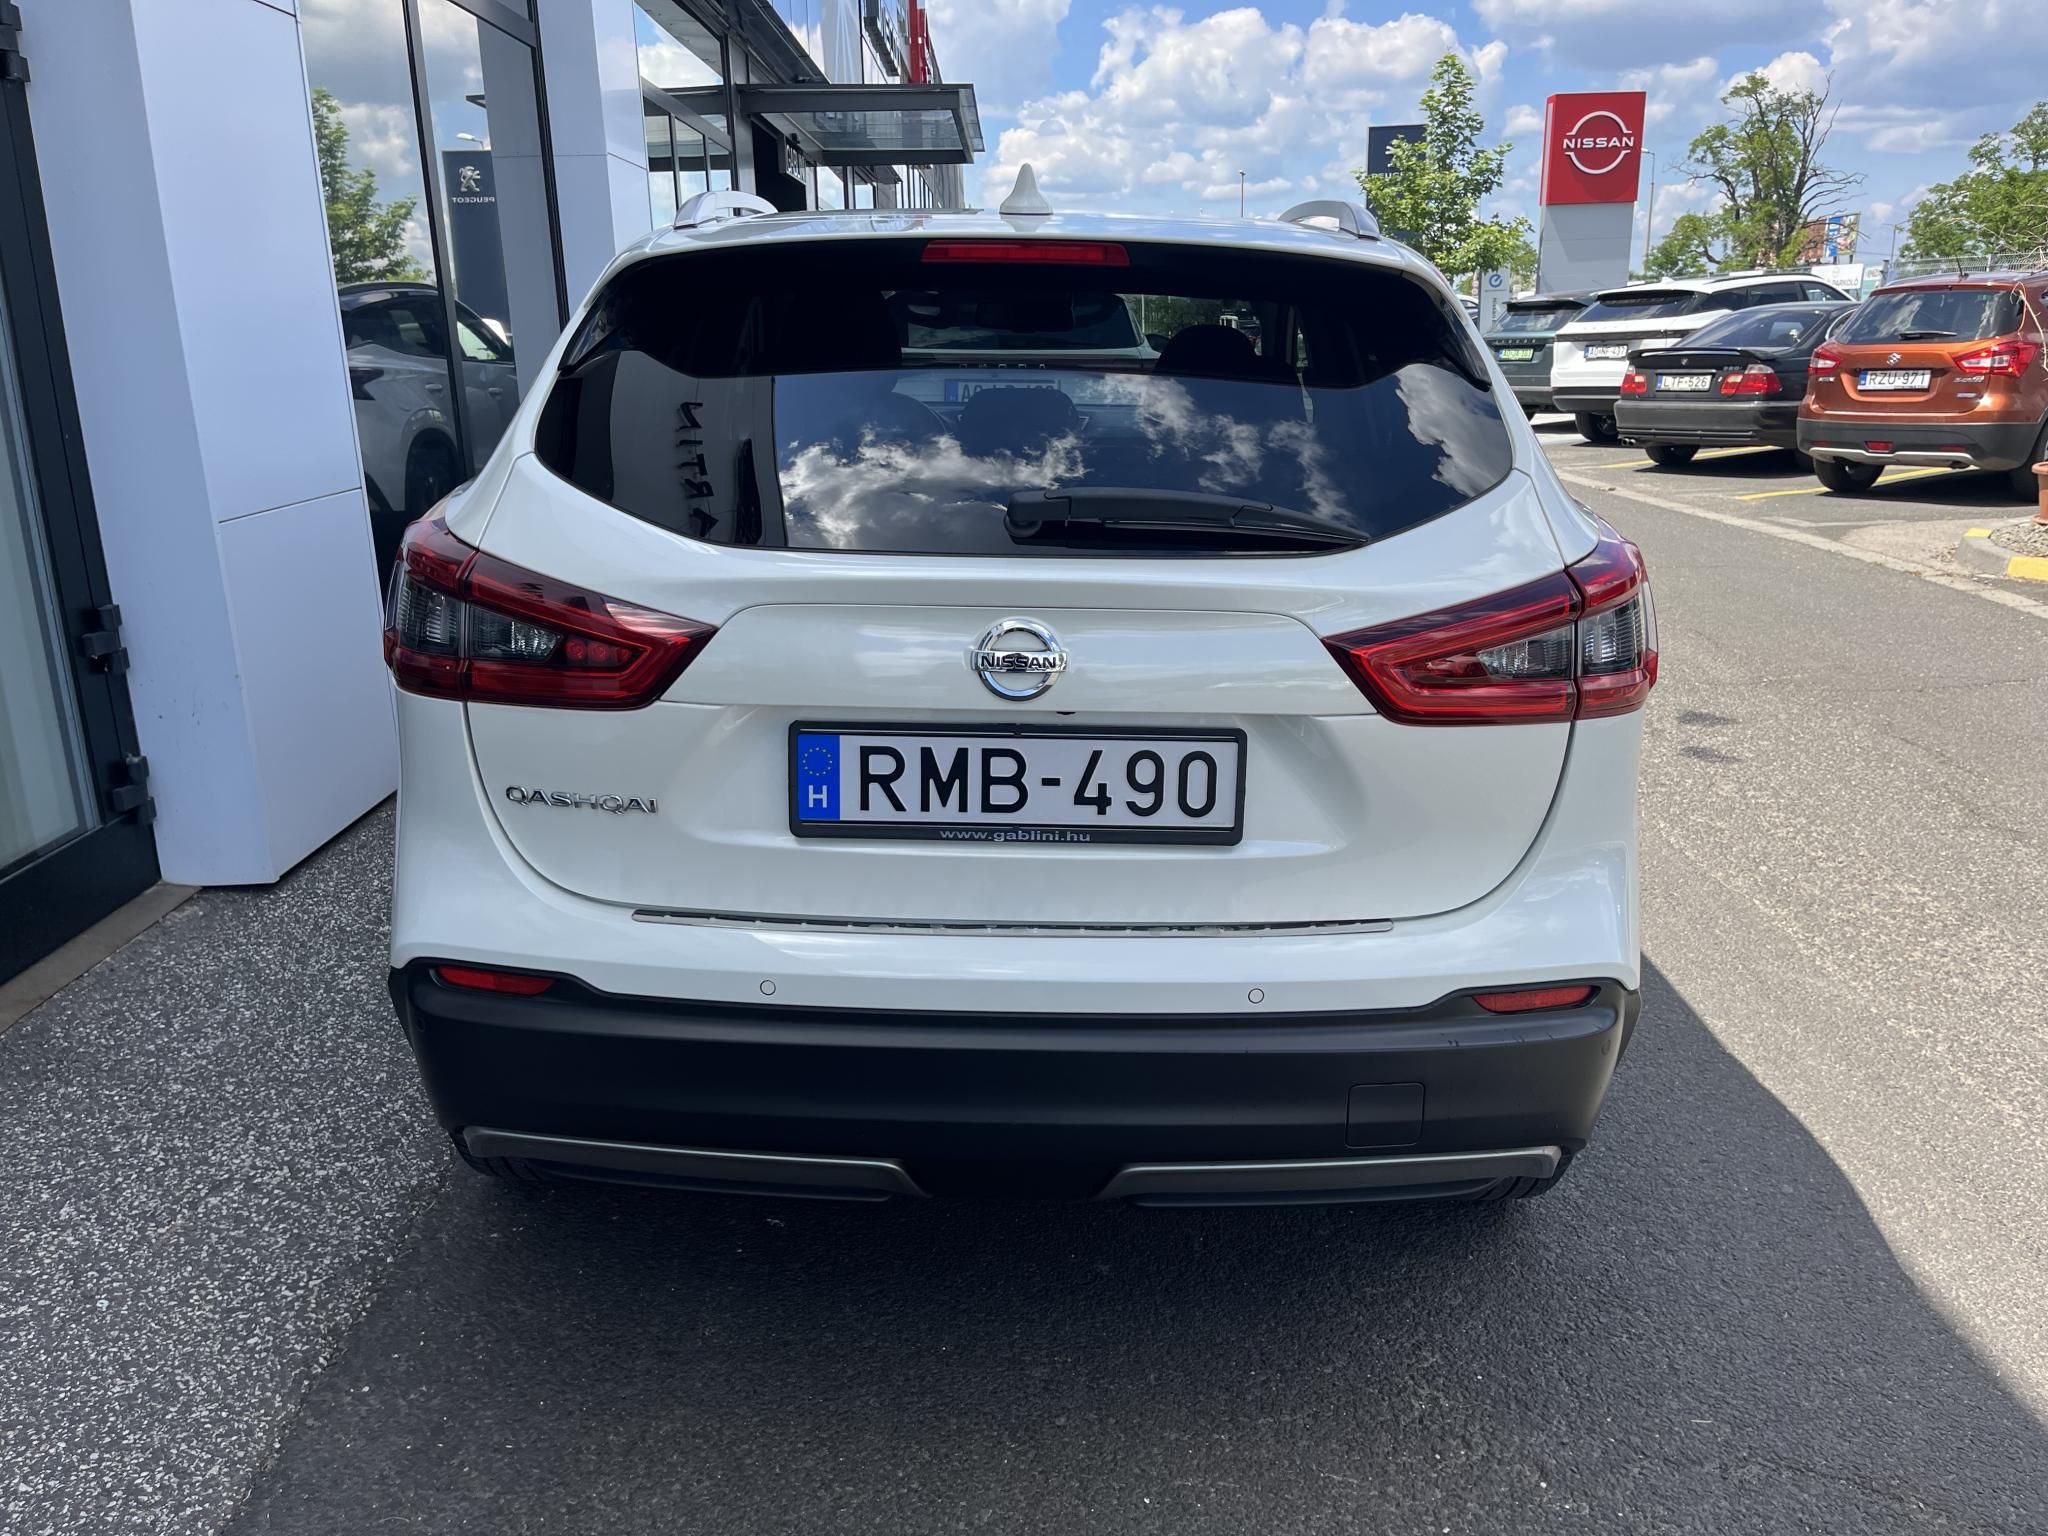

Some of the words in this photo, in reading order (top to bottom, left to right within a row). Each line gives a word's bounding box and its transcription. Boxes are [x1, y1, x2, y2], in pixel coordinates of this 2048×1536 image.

[1562, 136, 1635, 149] NISSAN
[1663, 375, 1708, 388] LTF-526
[1868, 371, 1927, 386] RZU-971
[980, 653, 1057, 669] NISSAN
[859, 745, 1218, 818] RMB-490
[505, 784, 659, 815] QASHQAI
[808, 784, 828, 808] H
[939, 830, 1091, 843] www.gablini.hu
